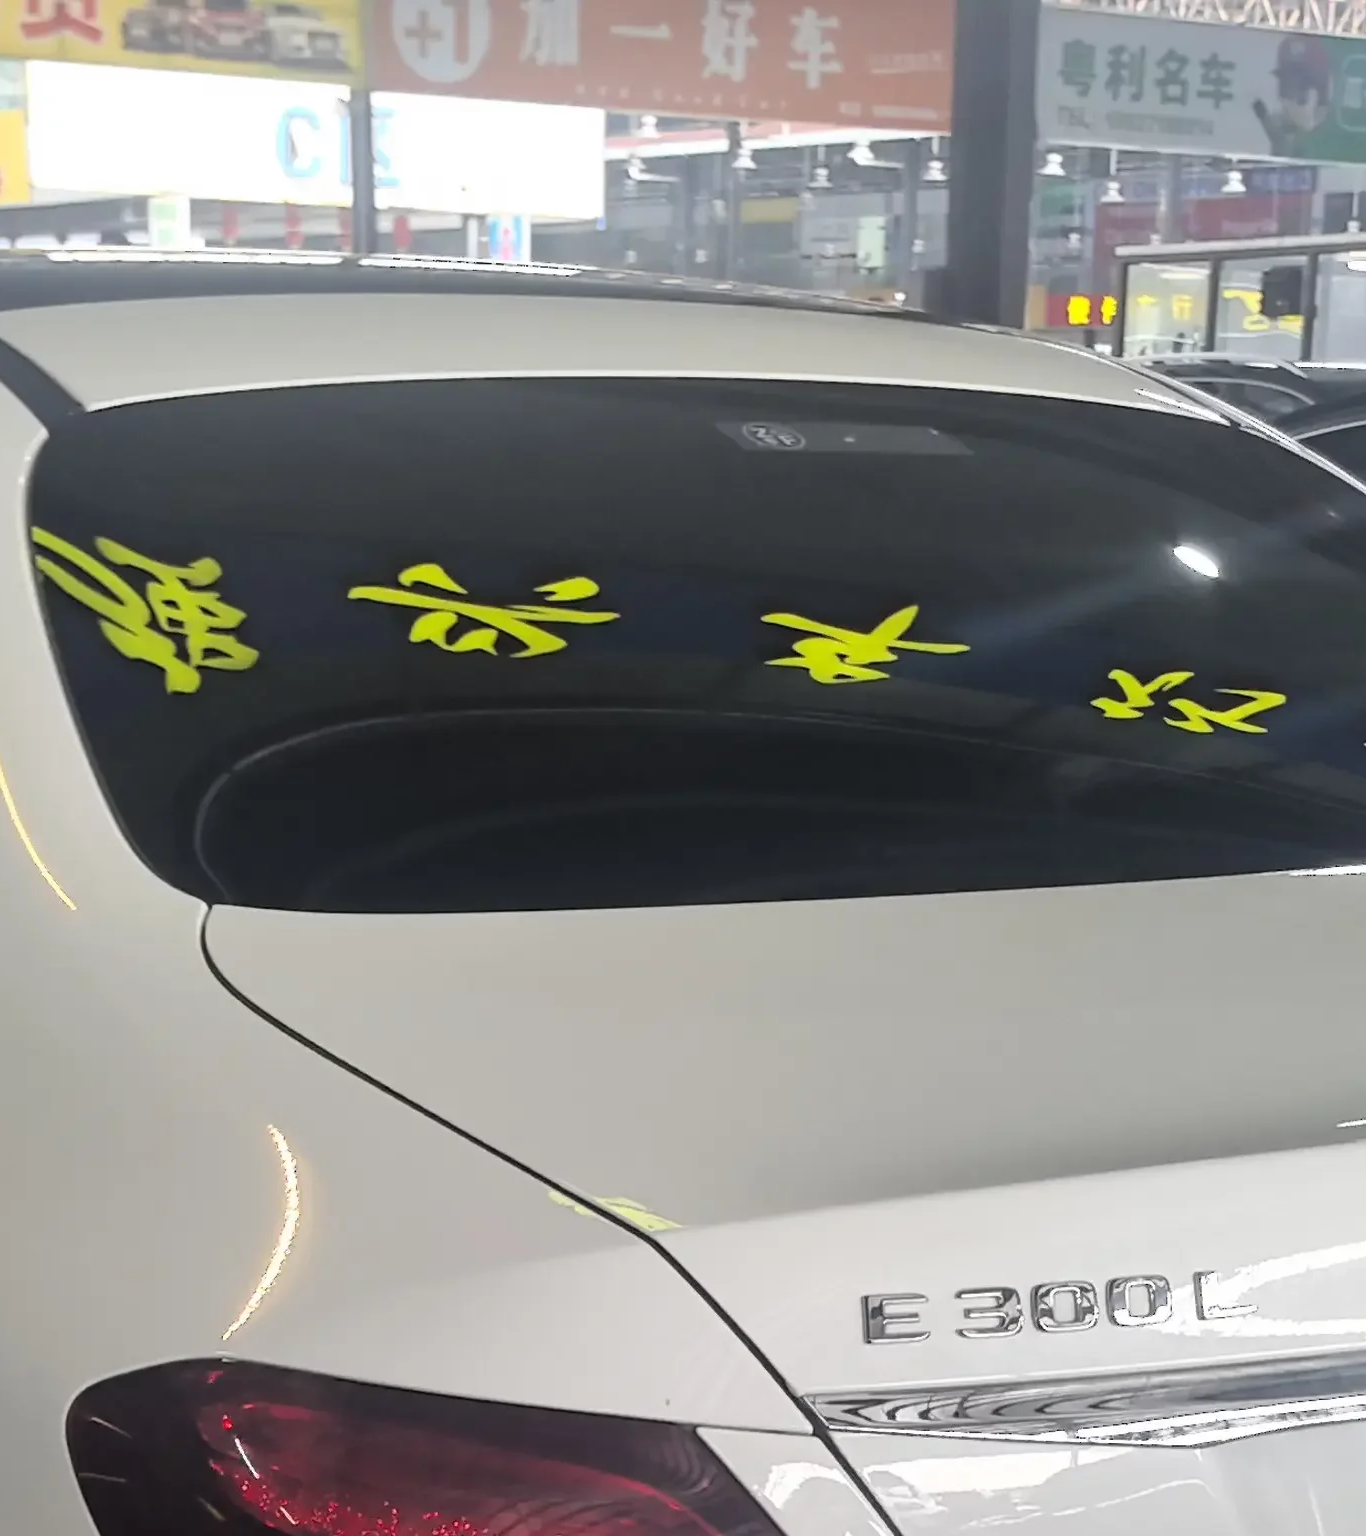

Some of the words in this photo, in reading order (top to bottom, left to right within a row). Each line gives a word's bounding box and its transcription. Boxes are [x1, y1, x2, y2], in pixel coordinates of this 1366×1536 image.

[518, 0, 843, 89] 加一好车
[1058, 38, 1237, 110] 粤利名车
[861, 1292, 931, 1344] E
